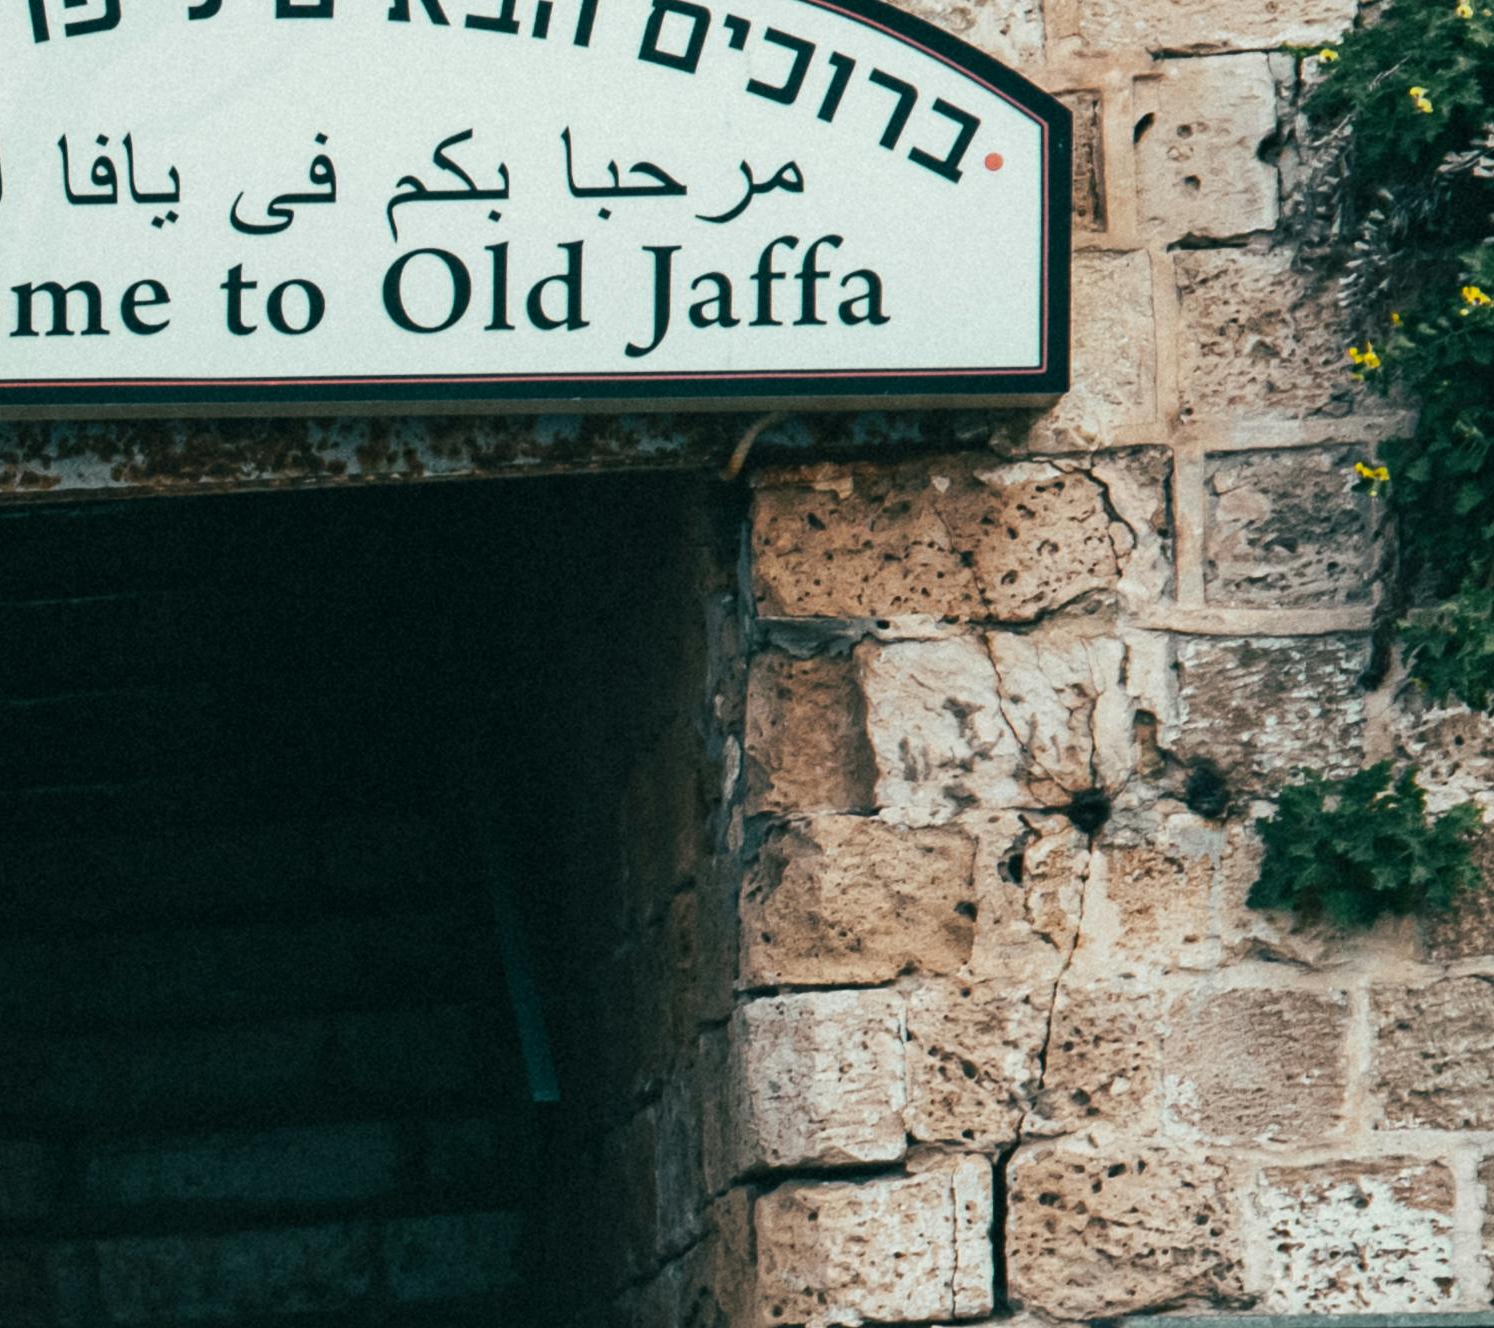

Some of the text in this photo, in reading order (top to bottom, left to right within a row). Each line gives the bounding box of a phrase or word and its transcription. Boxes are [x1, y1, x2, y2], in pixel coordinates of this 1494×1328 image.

[57, 132, 181, 230] يافا
[386, 127, 511, 244] بكم
[559, 126, 805, 224] مرحبا
[219, 263, 325, 336] to
[381, 240, 591, 334] Old
[623, 234, 891, 358] Jaffa
